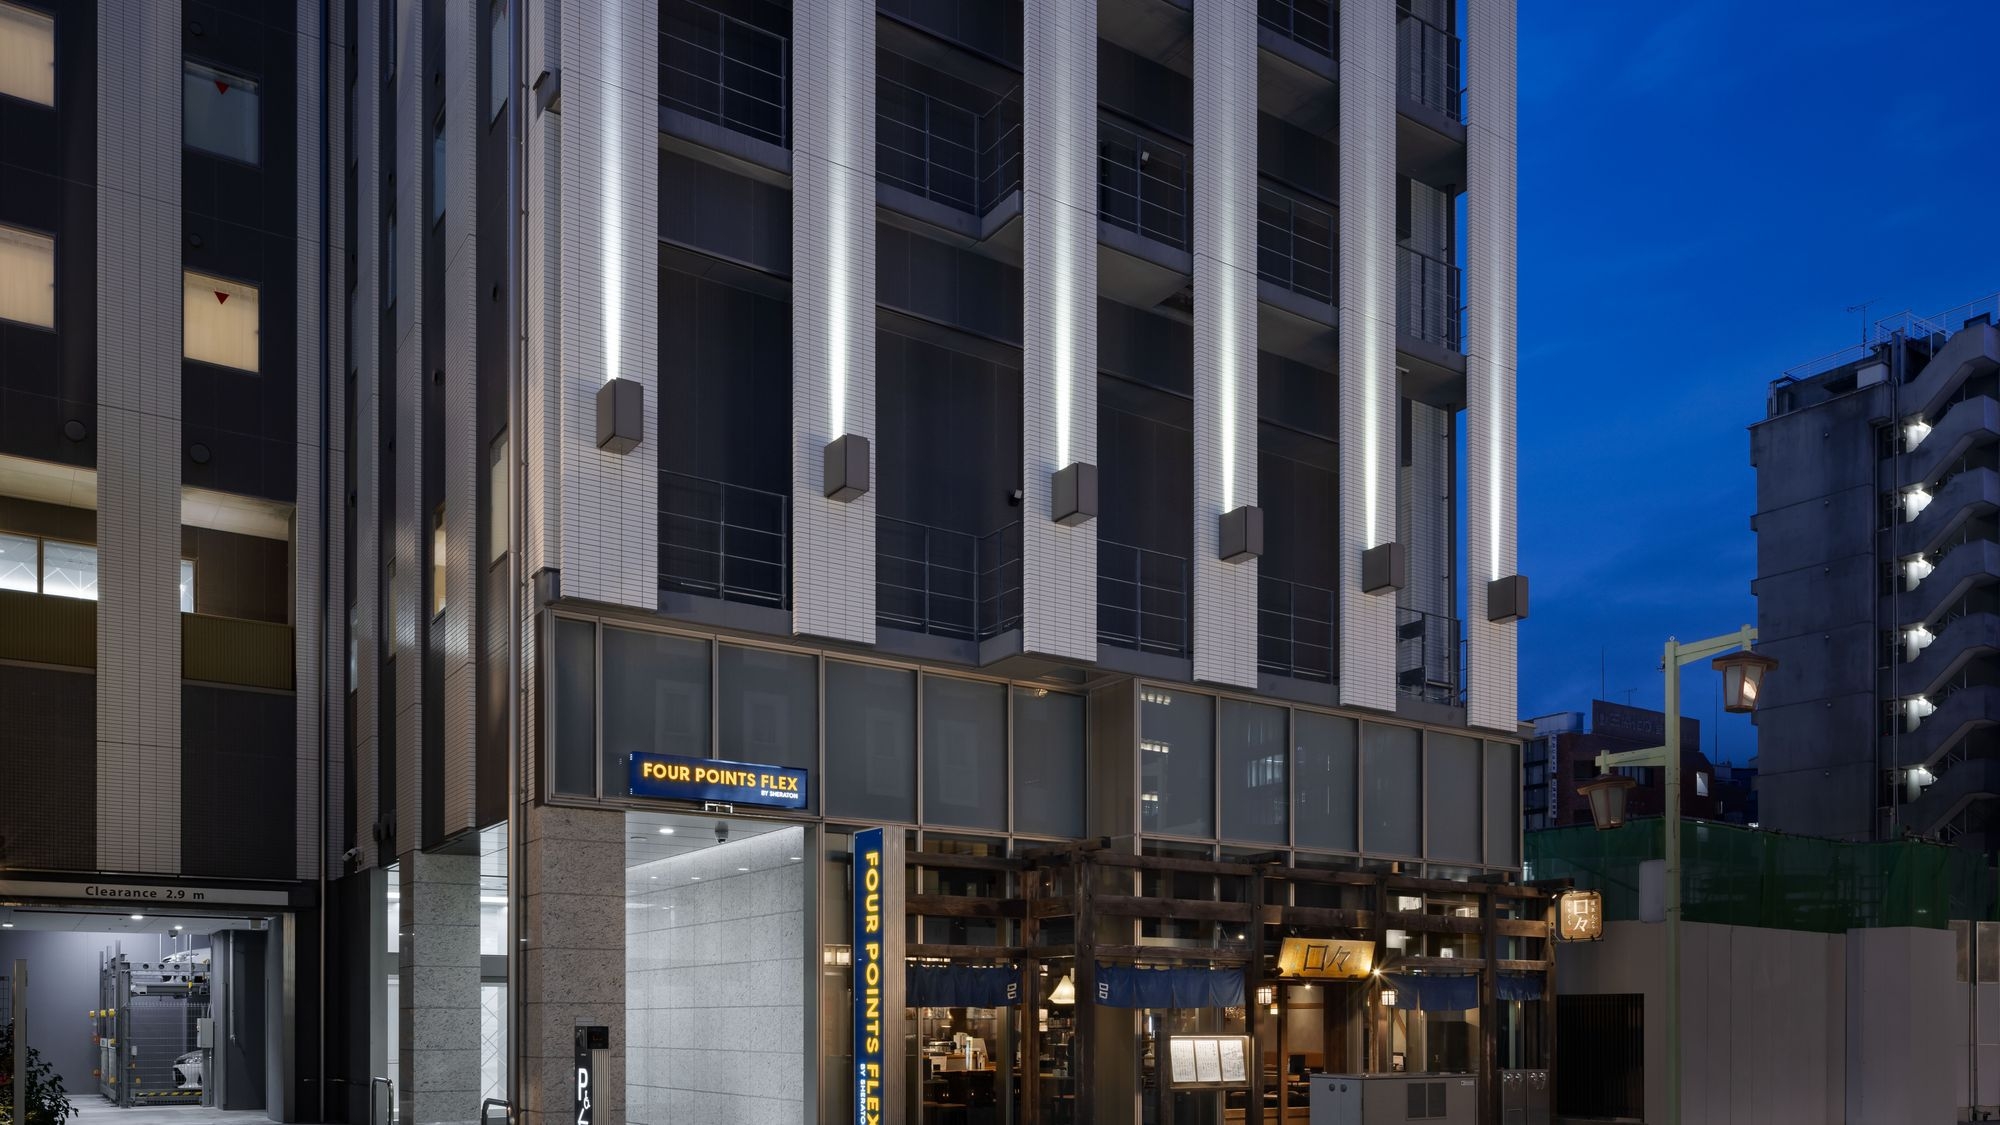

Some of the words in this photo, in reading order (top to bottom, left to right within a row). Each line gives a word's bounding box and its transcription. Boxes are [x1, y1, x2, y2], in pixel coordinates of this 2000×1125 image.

[643, 762, 691, 782] FOUR
[695, 768, 757, 788] POINTS
[760, 774, 799, 791] FLEX
[769, 791, 799, 799] SHERATON
[85, 886, 158, 898] Clearance
[166, 889, 186, 899] 2.9
[193, 892, 205, 900] m
[865, 851, 879, 933] FOUR
[865, 943, 879, 1054] POINTS
[578, 1067, 588, 1101] P
[860, 1063, 866, 1077] BY
[866, 1063, 880, 1125] FLEX
